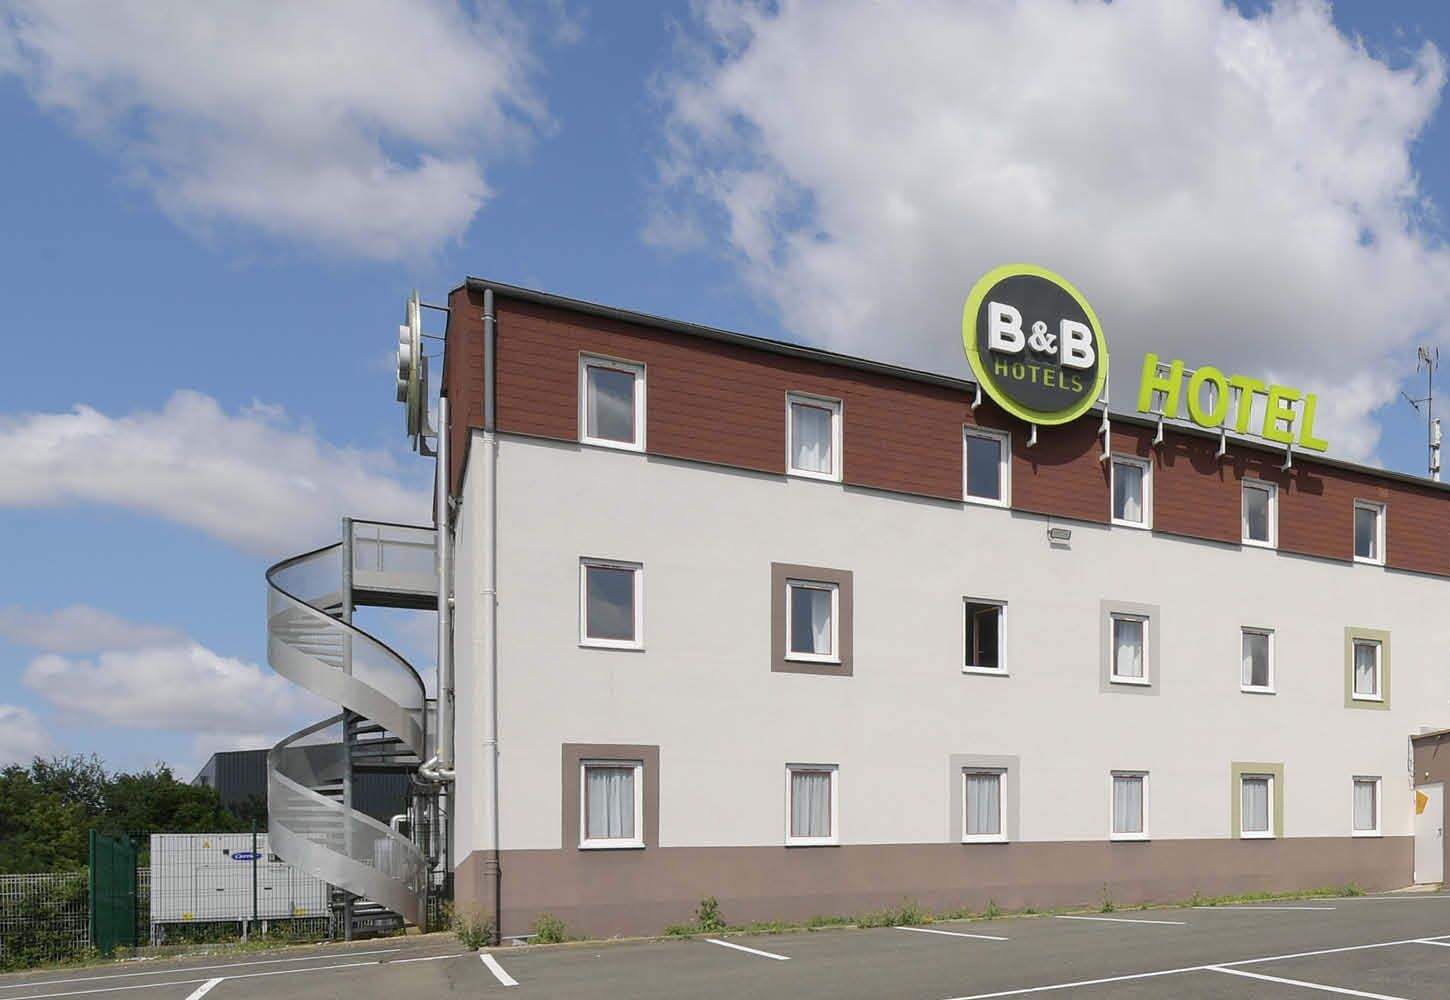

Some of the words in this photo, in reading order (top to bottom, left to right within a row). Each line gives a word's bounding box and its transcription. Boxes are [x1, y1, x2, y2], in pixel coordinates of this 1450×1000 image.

[988, 301, 1096, 369] B&B
[994, 359, 1083, 393] HOTELS
[1136, 353, 1329, 452] HOTEL
